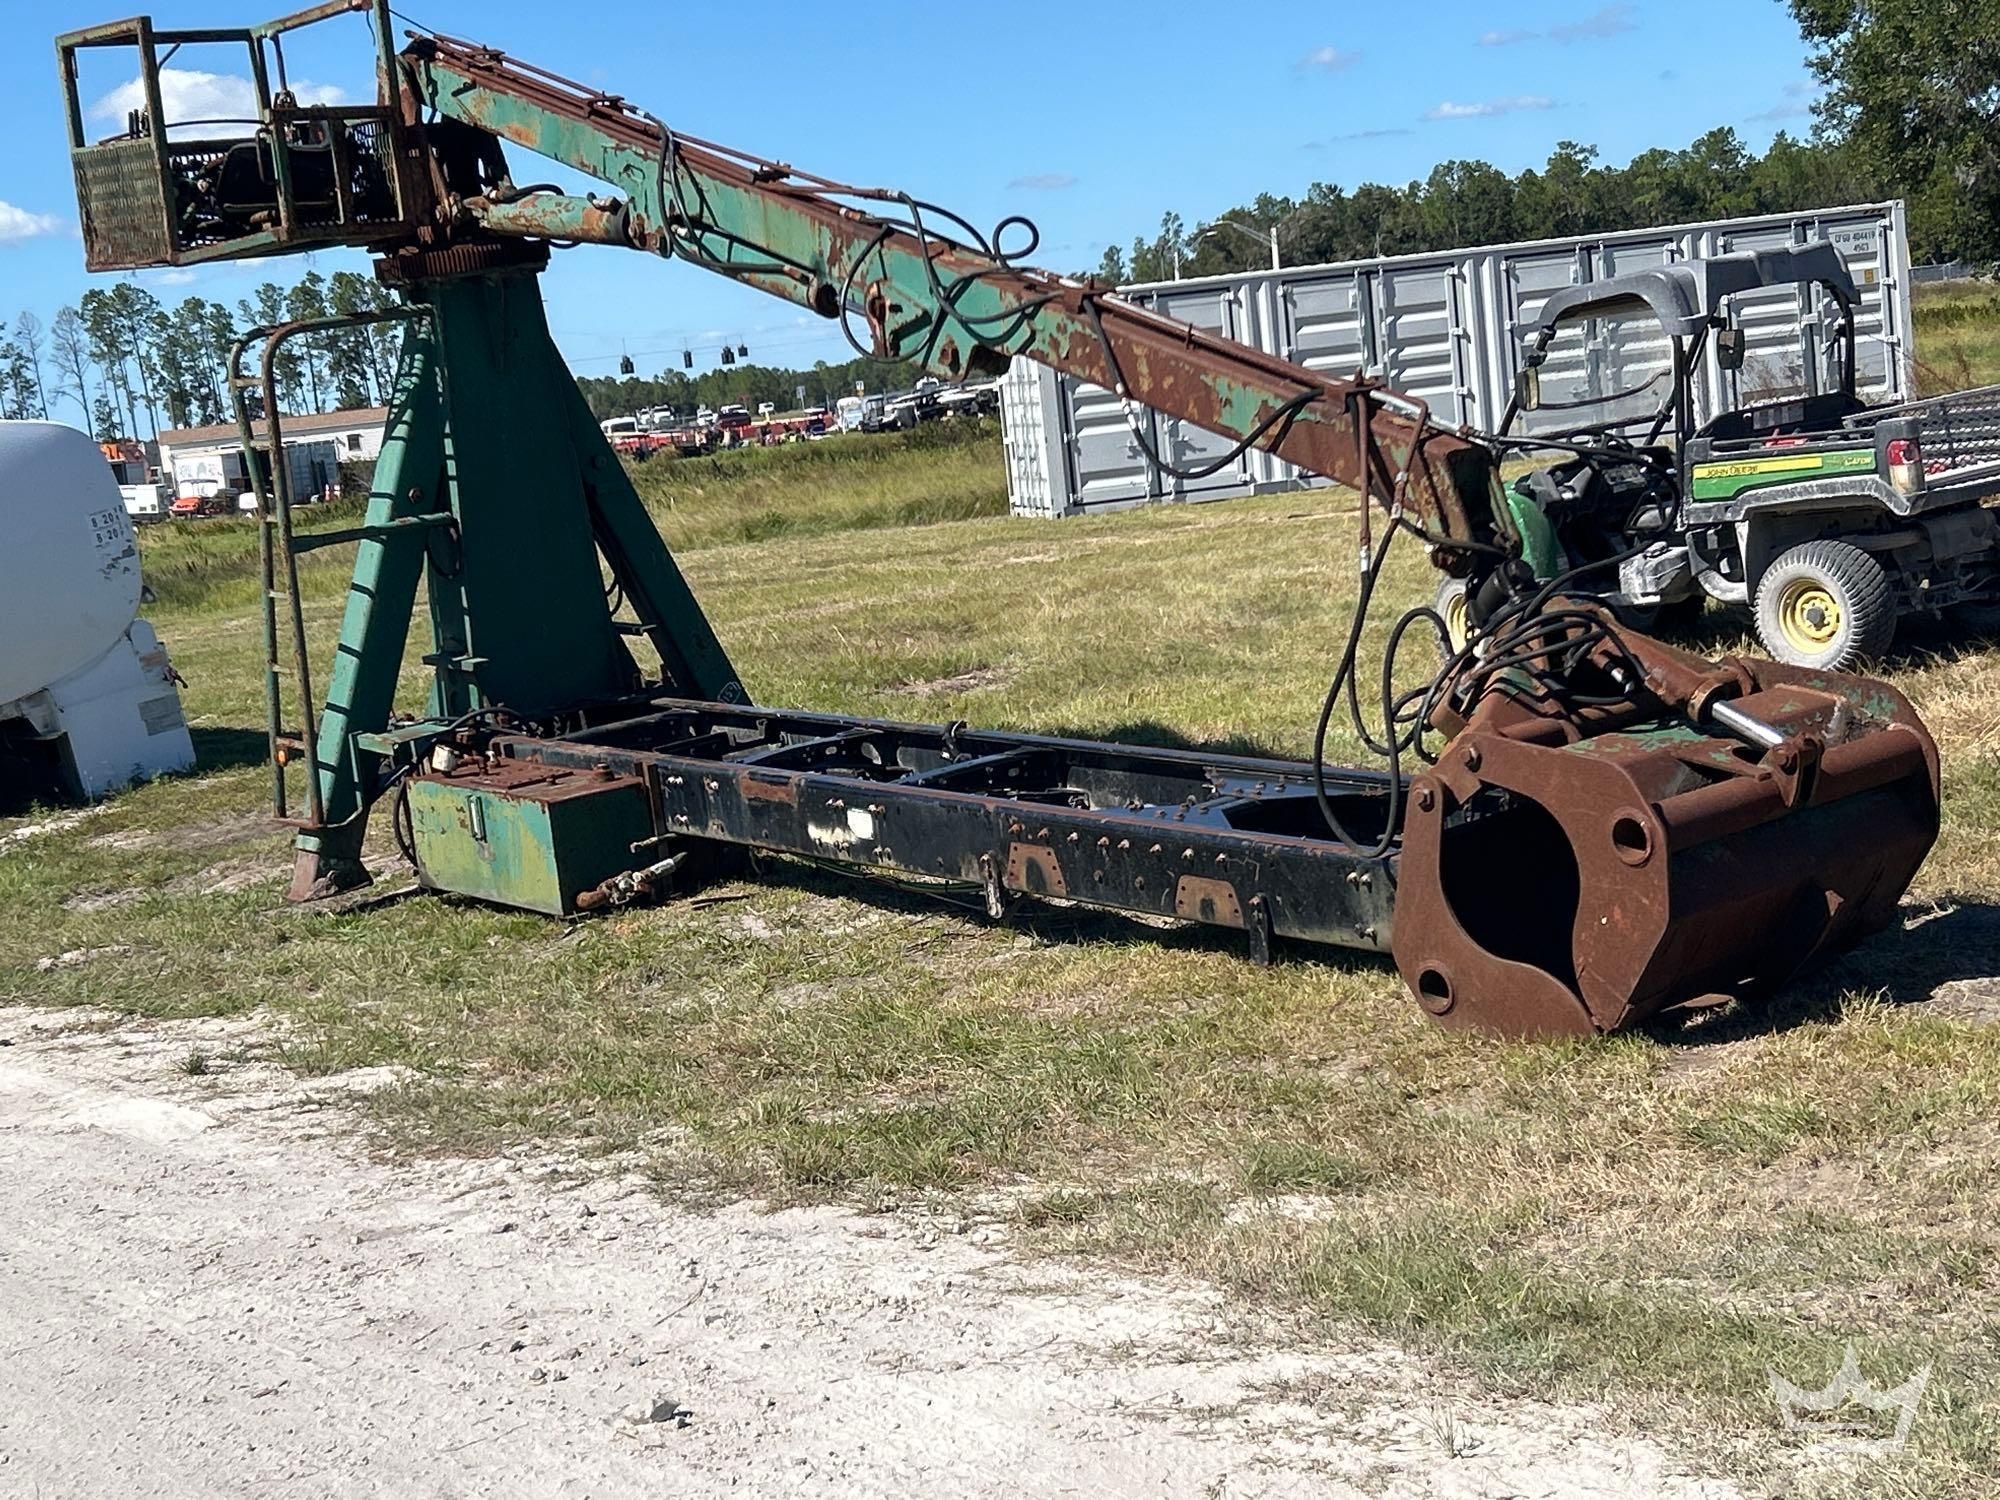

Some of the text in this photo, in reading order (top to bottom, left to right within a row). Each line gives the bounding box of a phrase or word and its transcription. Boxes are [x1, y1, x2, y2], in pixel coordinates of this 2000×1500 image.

[1706, 465, 1758, 477] JOHN DEERE
[102, 512, 114, 524] 20
